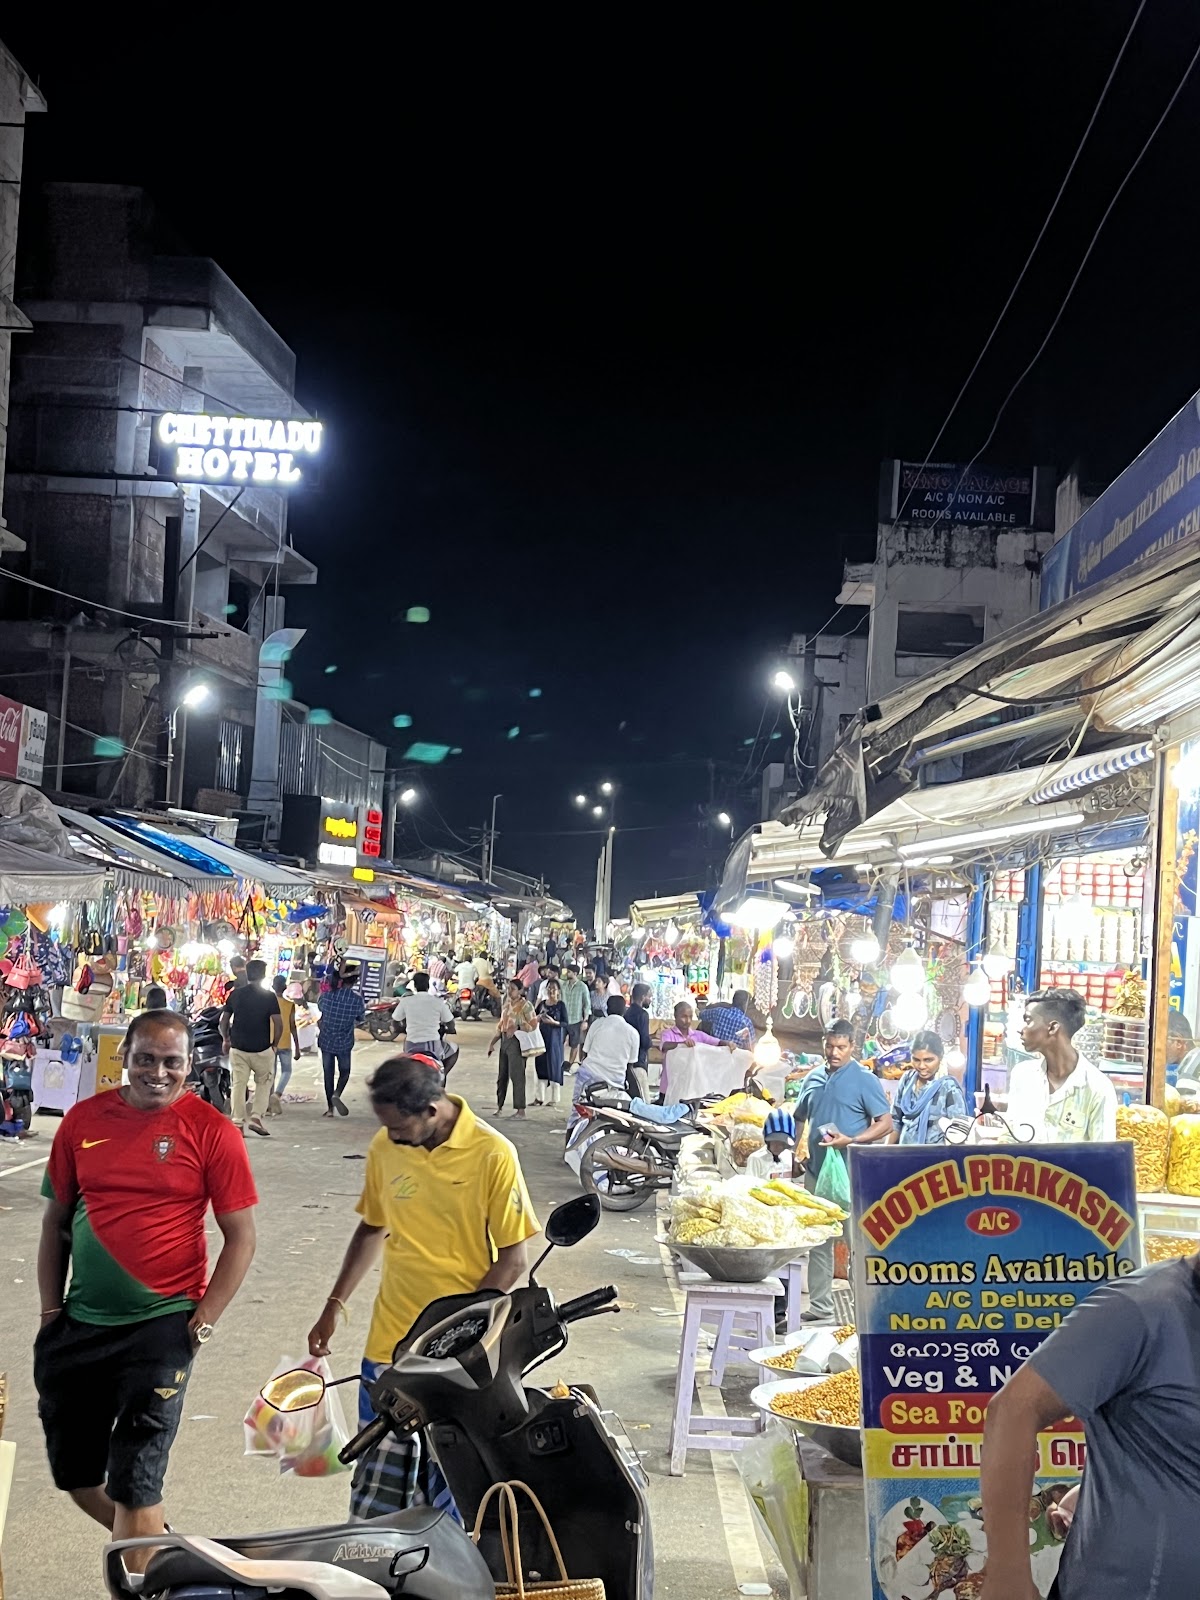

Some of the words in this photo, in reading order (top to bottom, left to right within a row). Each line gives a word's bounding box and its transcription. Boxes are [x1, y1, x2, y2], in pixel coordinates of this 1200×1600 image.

[159, 412, 323, 452] CHETTINADU
[176, 447, 301, 481] HOTEL
[924, 492, 943, 502] A/C
[957, 494, 983, 504] NON
[985, 496, 1005, 505] A/C
[912, 508, 952, 519] ROOMS
[954, 512, 1016, 523] AVAILABLE
[860, 1162, 967, 1249] HOTEL
[966, 1156, 1134, 1249] PRAKASH
[977, 1211, 1011, 1231] A/C
[865, 1255, 976, 1284] Rooms
[984, 1252, 1136, 1284] Available
[925, 1290, 972, 1310] A/C
[980, 1289, 1077, 1310] Deluxe
[889, 1312, 947, 1332] Non
[955, 1312, 1005, 1331] A/C
[1014, 1311, 1064, 1331] Del
[882, 1365, 944, 1393] Veg
[954, 1365, 979, 1388] &
[890, 1400, 940, 1425] Sea
